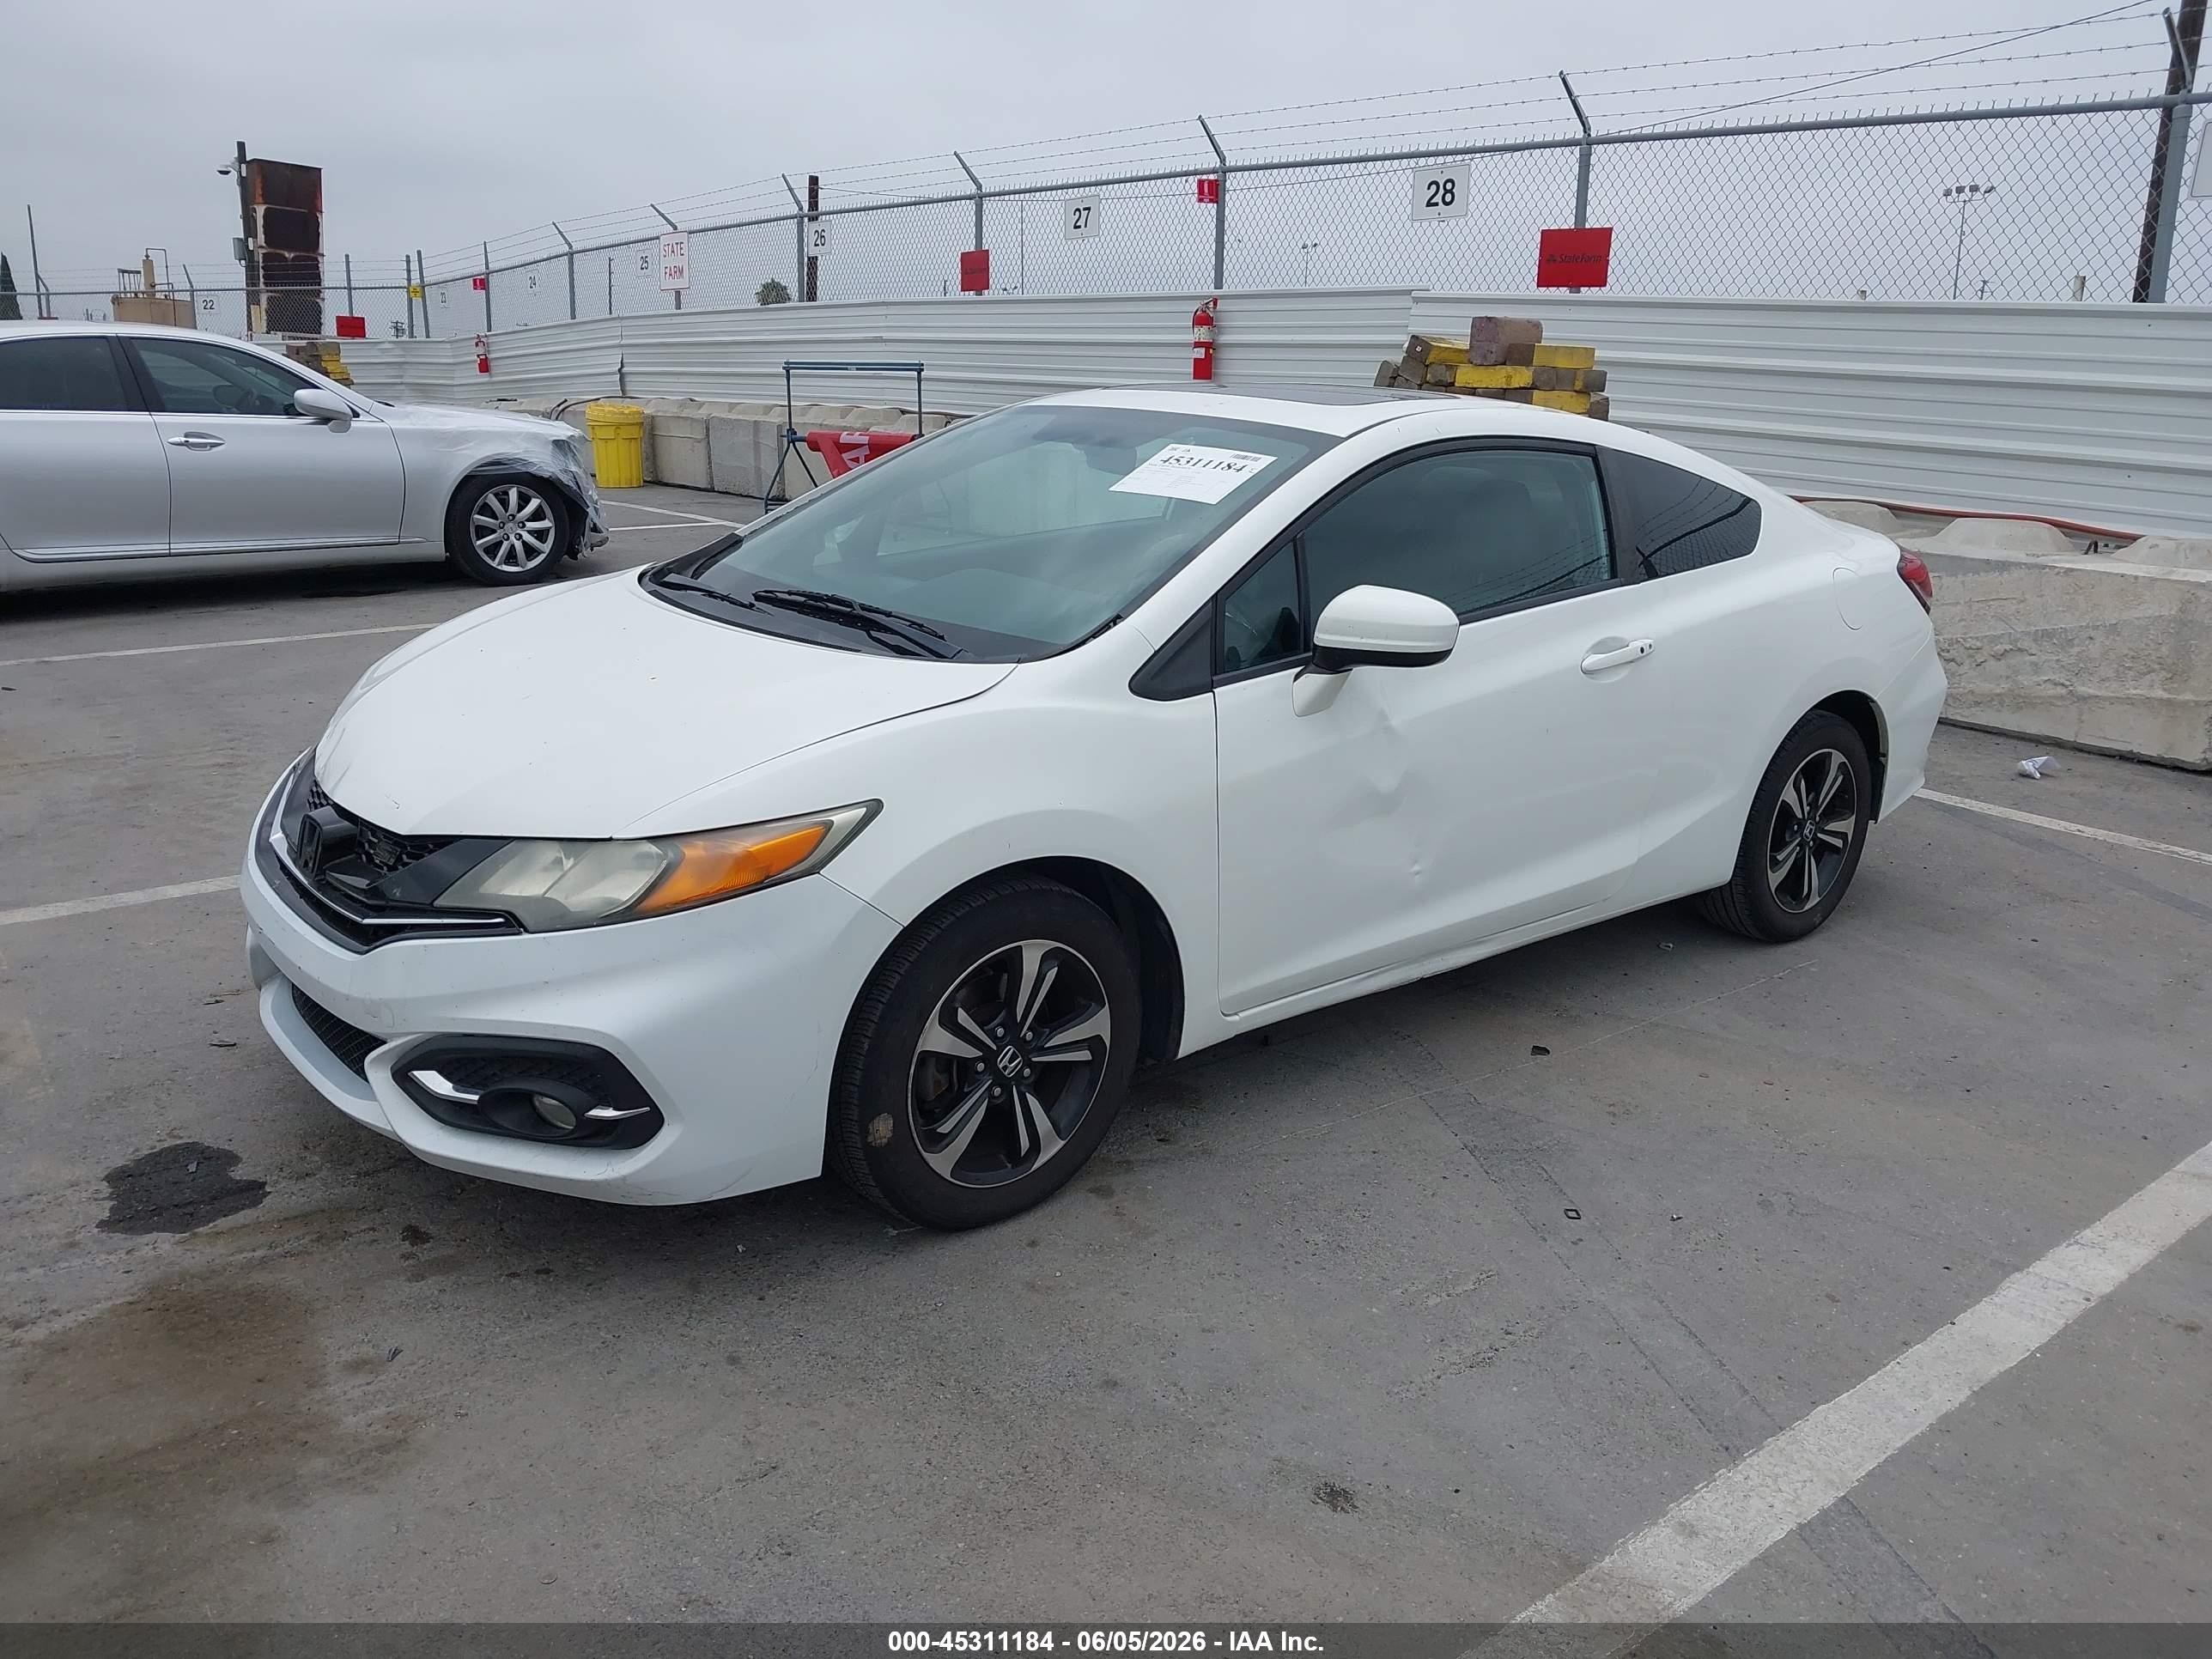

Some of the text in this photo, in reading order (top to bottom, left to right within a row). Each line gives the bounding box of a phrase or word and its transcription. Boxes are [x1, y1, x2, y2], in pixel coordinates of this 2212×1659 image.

[1425, 178, 1455, 208] 28
[1073, 206, 1091, 230] 27
[813, 229, 826, 247] 26
[663, 241, 684, 258] STATE
[640, 256, 649, 270] 25
[664, 264, 684, 281] FARM
[528, 276, 537, 289] 24
[202, 299, 215, 310] 22
[441, 292, 447, 304] 23
[1160, 454, 1248, 473] 45311184
